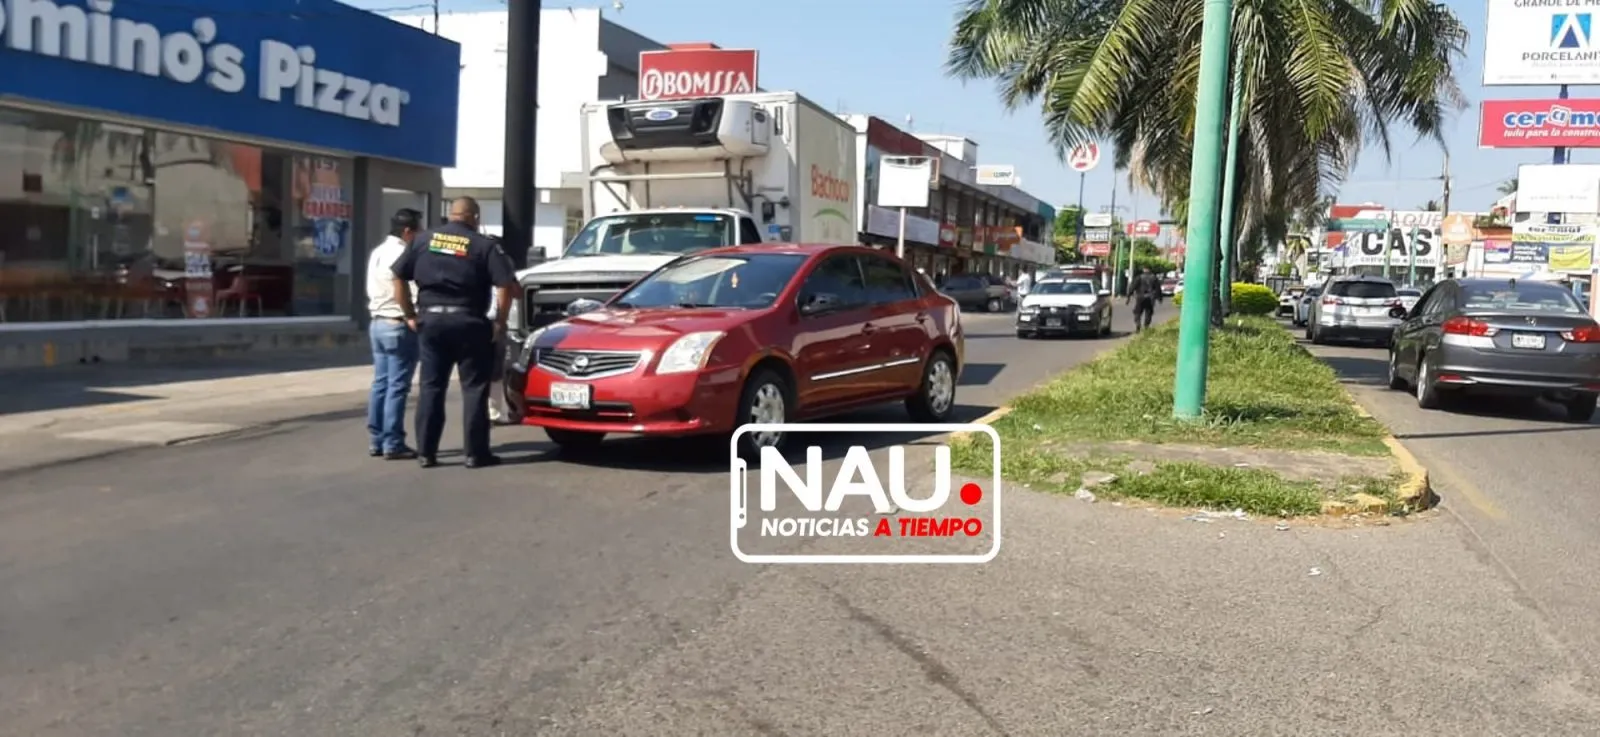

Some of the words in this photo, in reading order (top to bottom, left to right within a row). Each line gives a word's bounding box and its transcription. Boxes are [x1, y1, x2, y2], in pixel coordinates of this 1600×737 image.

[0, 0, 246, 93] mino's
[258, 39, 402, 127] Pizza
[1526, 129, 1549, 139] para
[1550, 127, 1561, 137] la
